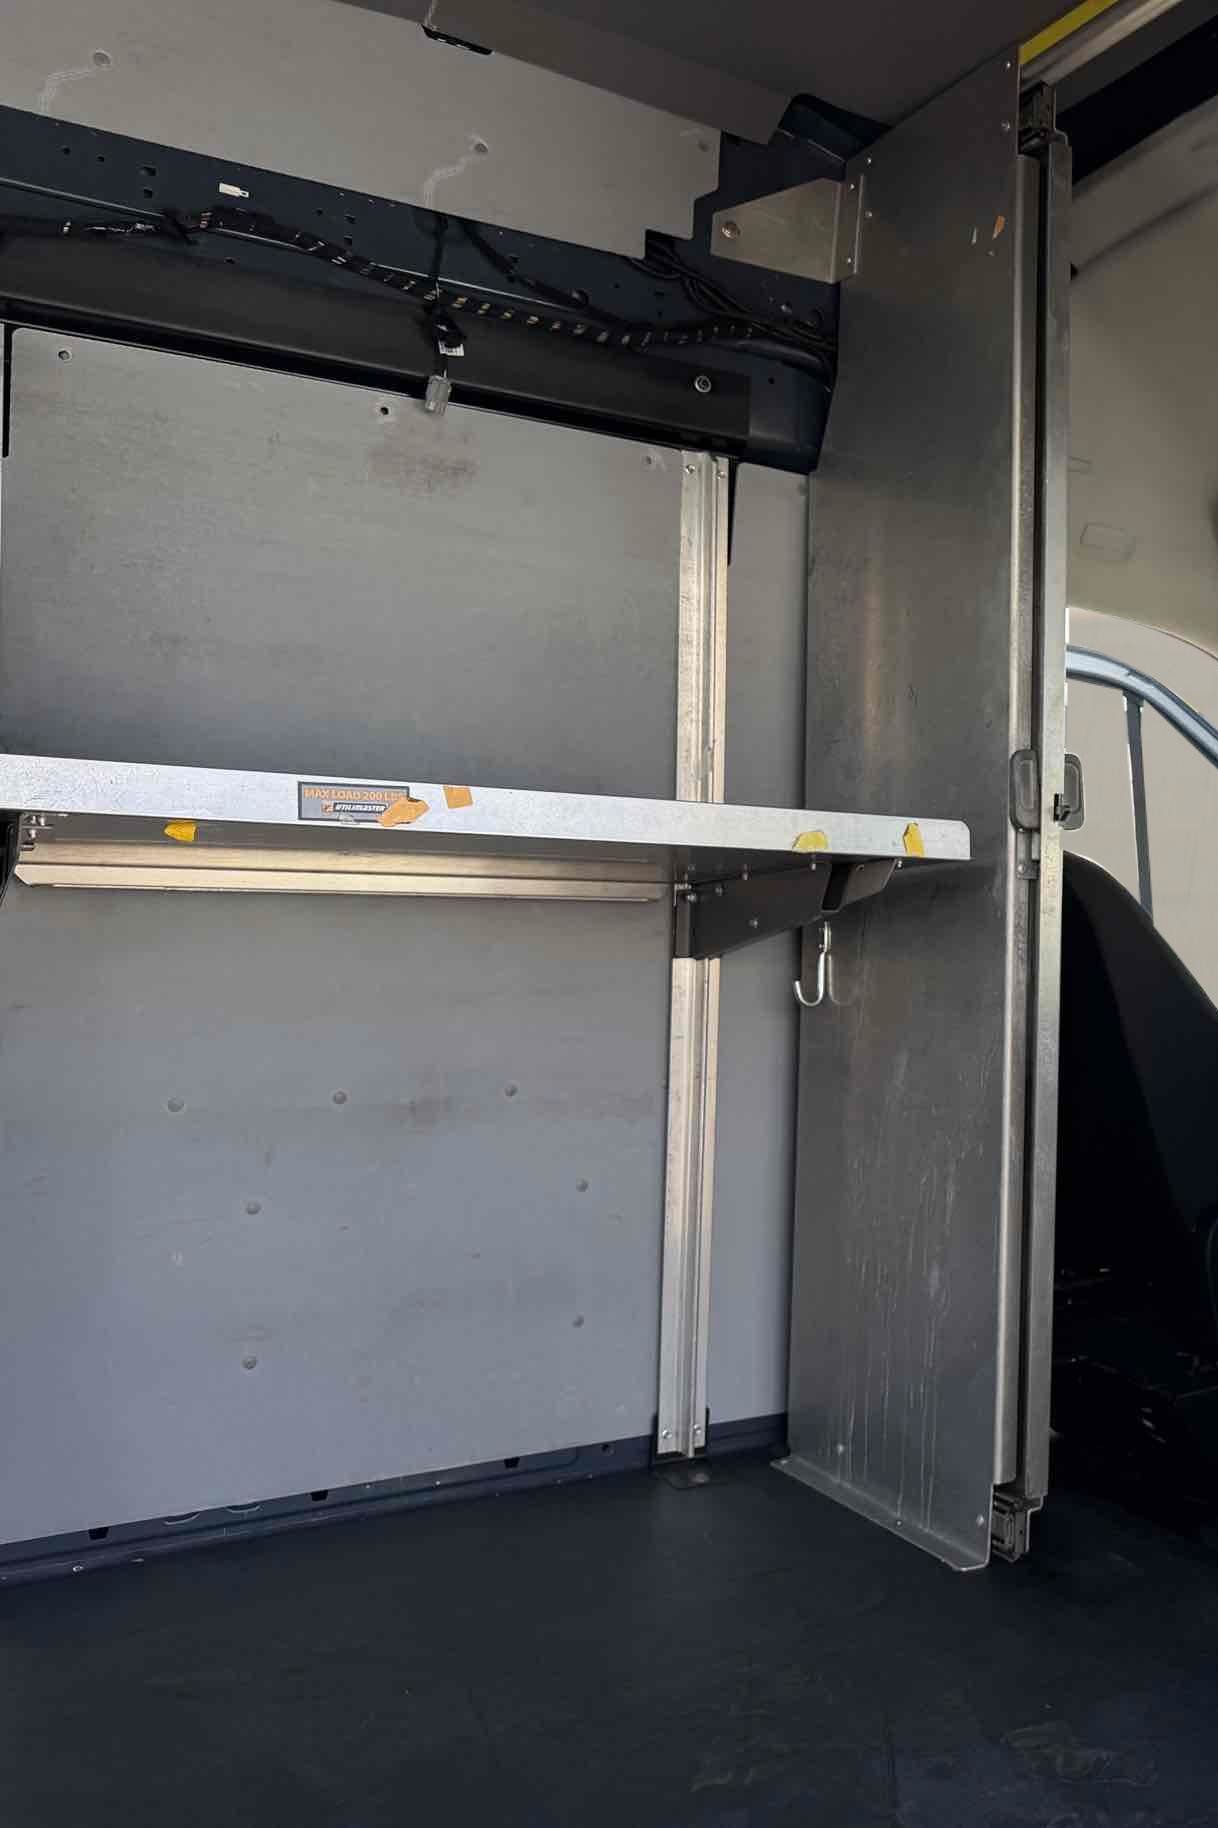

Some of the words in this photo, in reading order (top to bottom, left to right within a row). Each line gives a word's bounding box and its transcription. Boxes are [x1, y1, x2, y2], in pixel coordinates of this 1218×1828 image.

[303, 787, 329, 799] MAX
[333, 789, 362, 801] LOAD
[364, 791, 383, 801] 200
